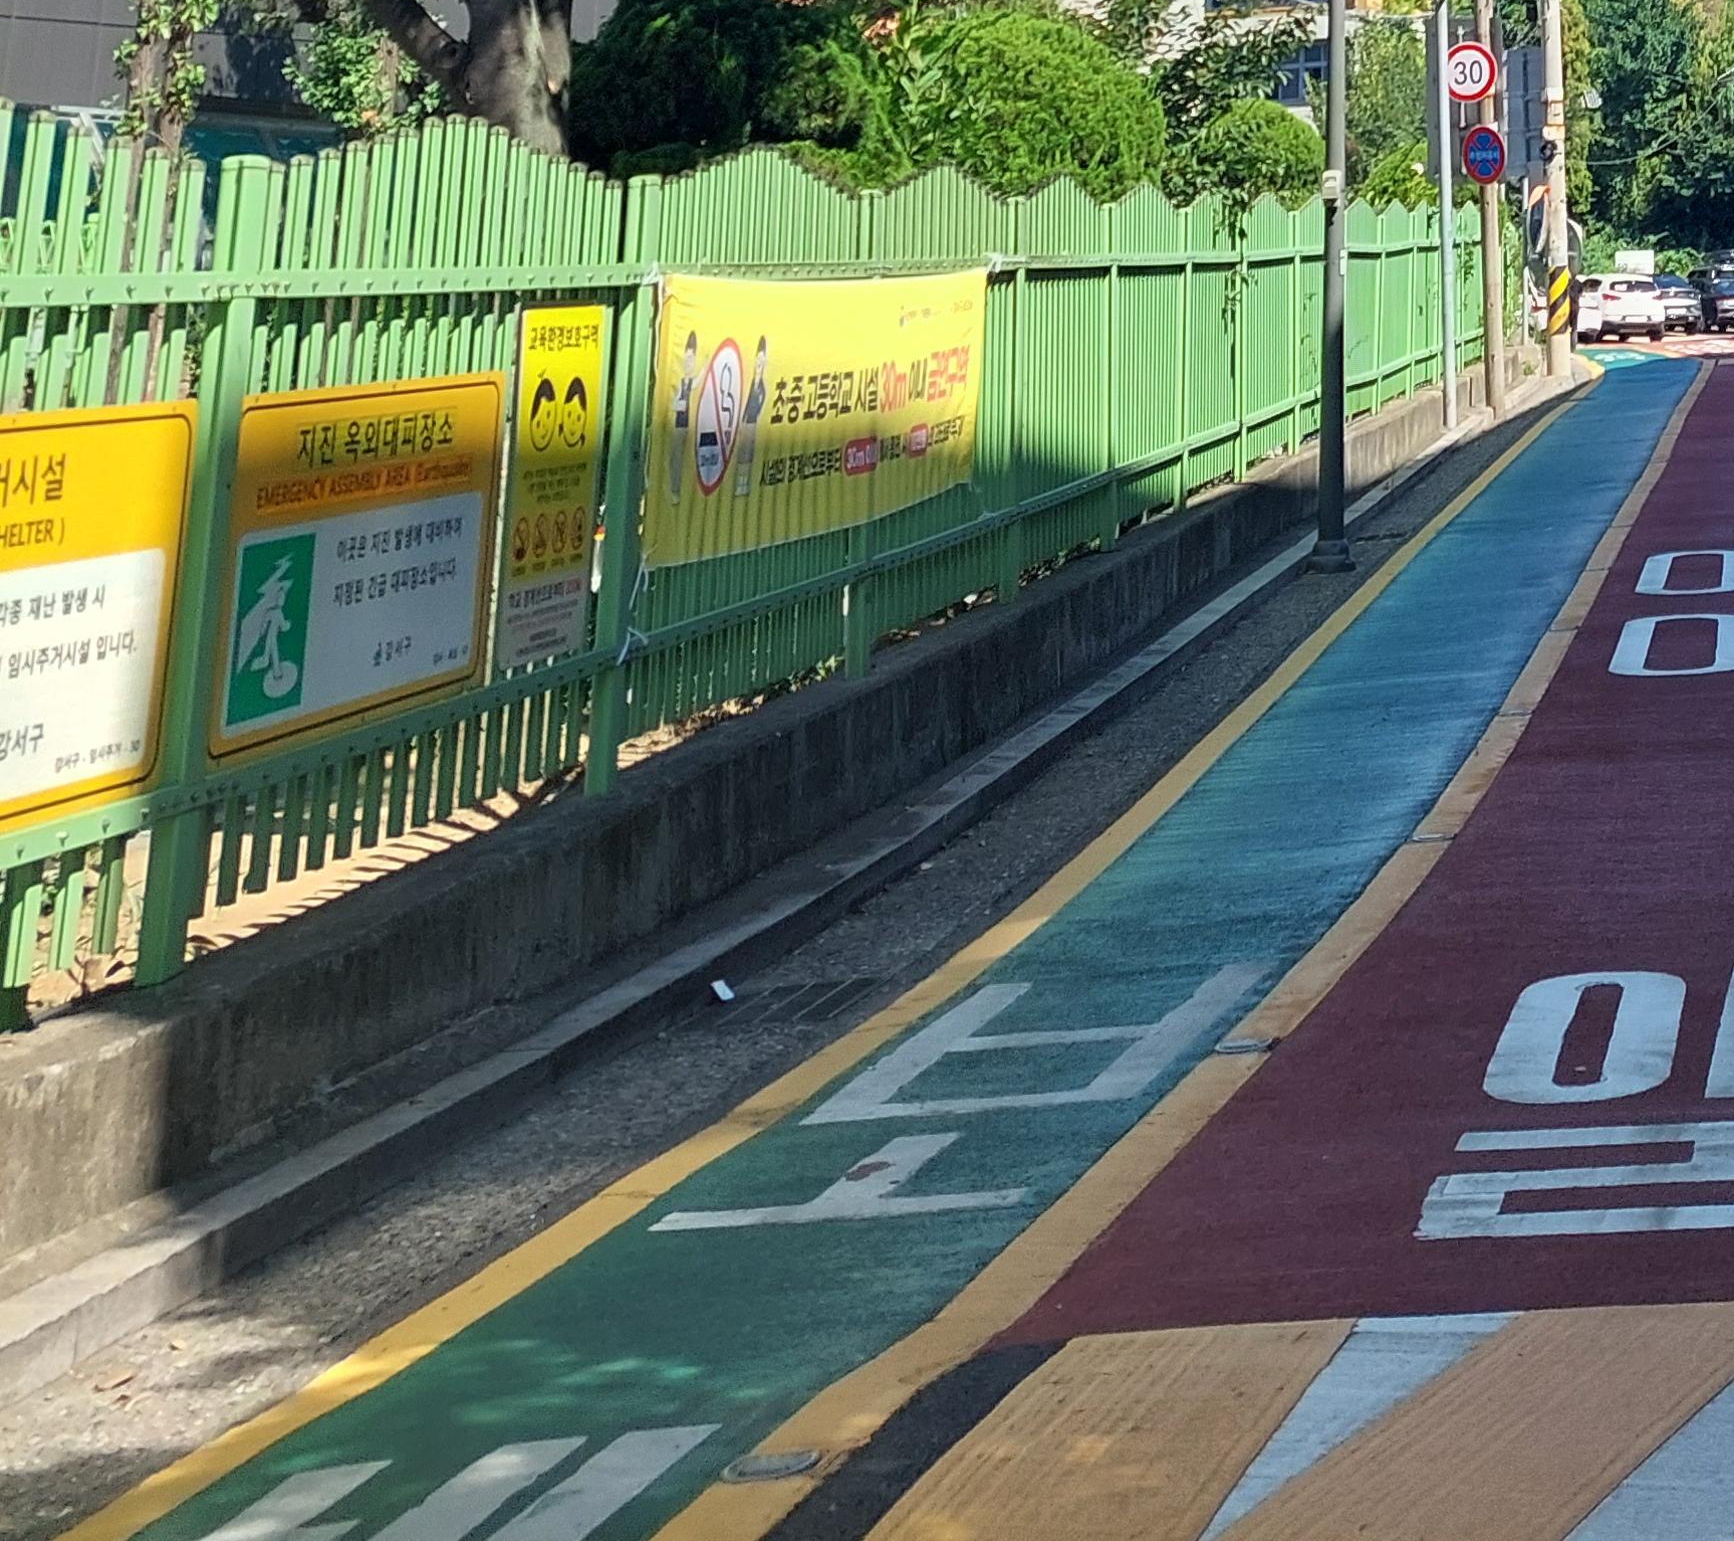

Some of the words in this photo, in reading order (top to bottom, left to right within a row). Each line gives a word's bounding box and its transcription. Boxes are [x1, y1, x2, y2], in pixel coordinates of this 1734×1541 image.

[1453, 59, 1483, 86] 30
[854, 366, 879, 413] 시설
[880, 358, 907, 414] 30m
[927, 344, 970, 403] 금연구역
[296, 423, 337, 469] 지진
[344, 410, 455, 464] 옥외대피장소
[256, 476, 324, 510] EMERGENCY
[386, 462, 411, 488] AREA
[336, 534, 367, 563] 이곳은
[370, 528, 390, 555] 지진
[28, 591, 57, 622] 재난
[61, 586, 89, 616] 발생
[92, 583, 107, 609] 시
[368, 572, 387, 600] 긴급
[8, 638, 92, 680] 임시주거시설
[96, 629, 138, 662] 입니다.
